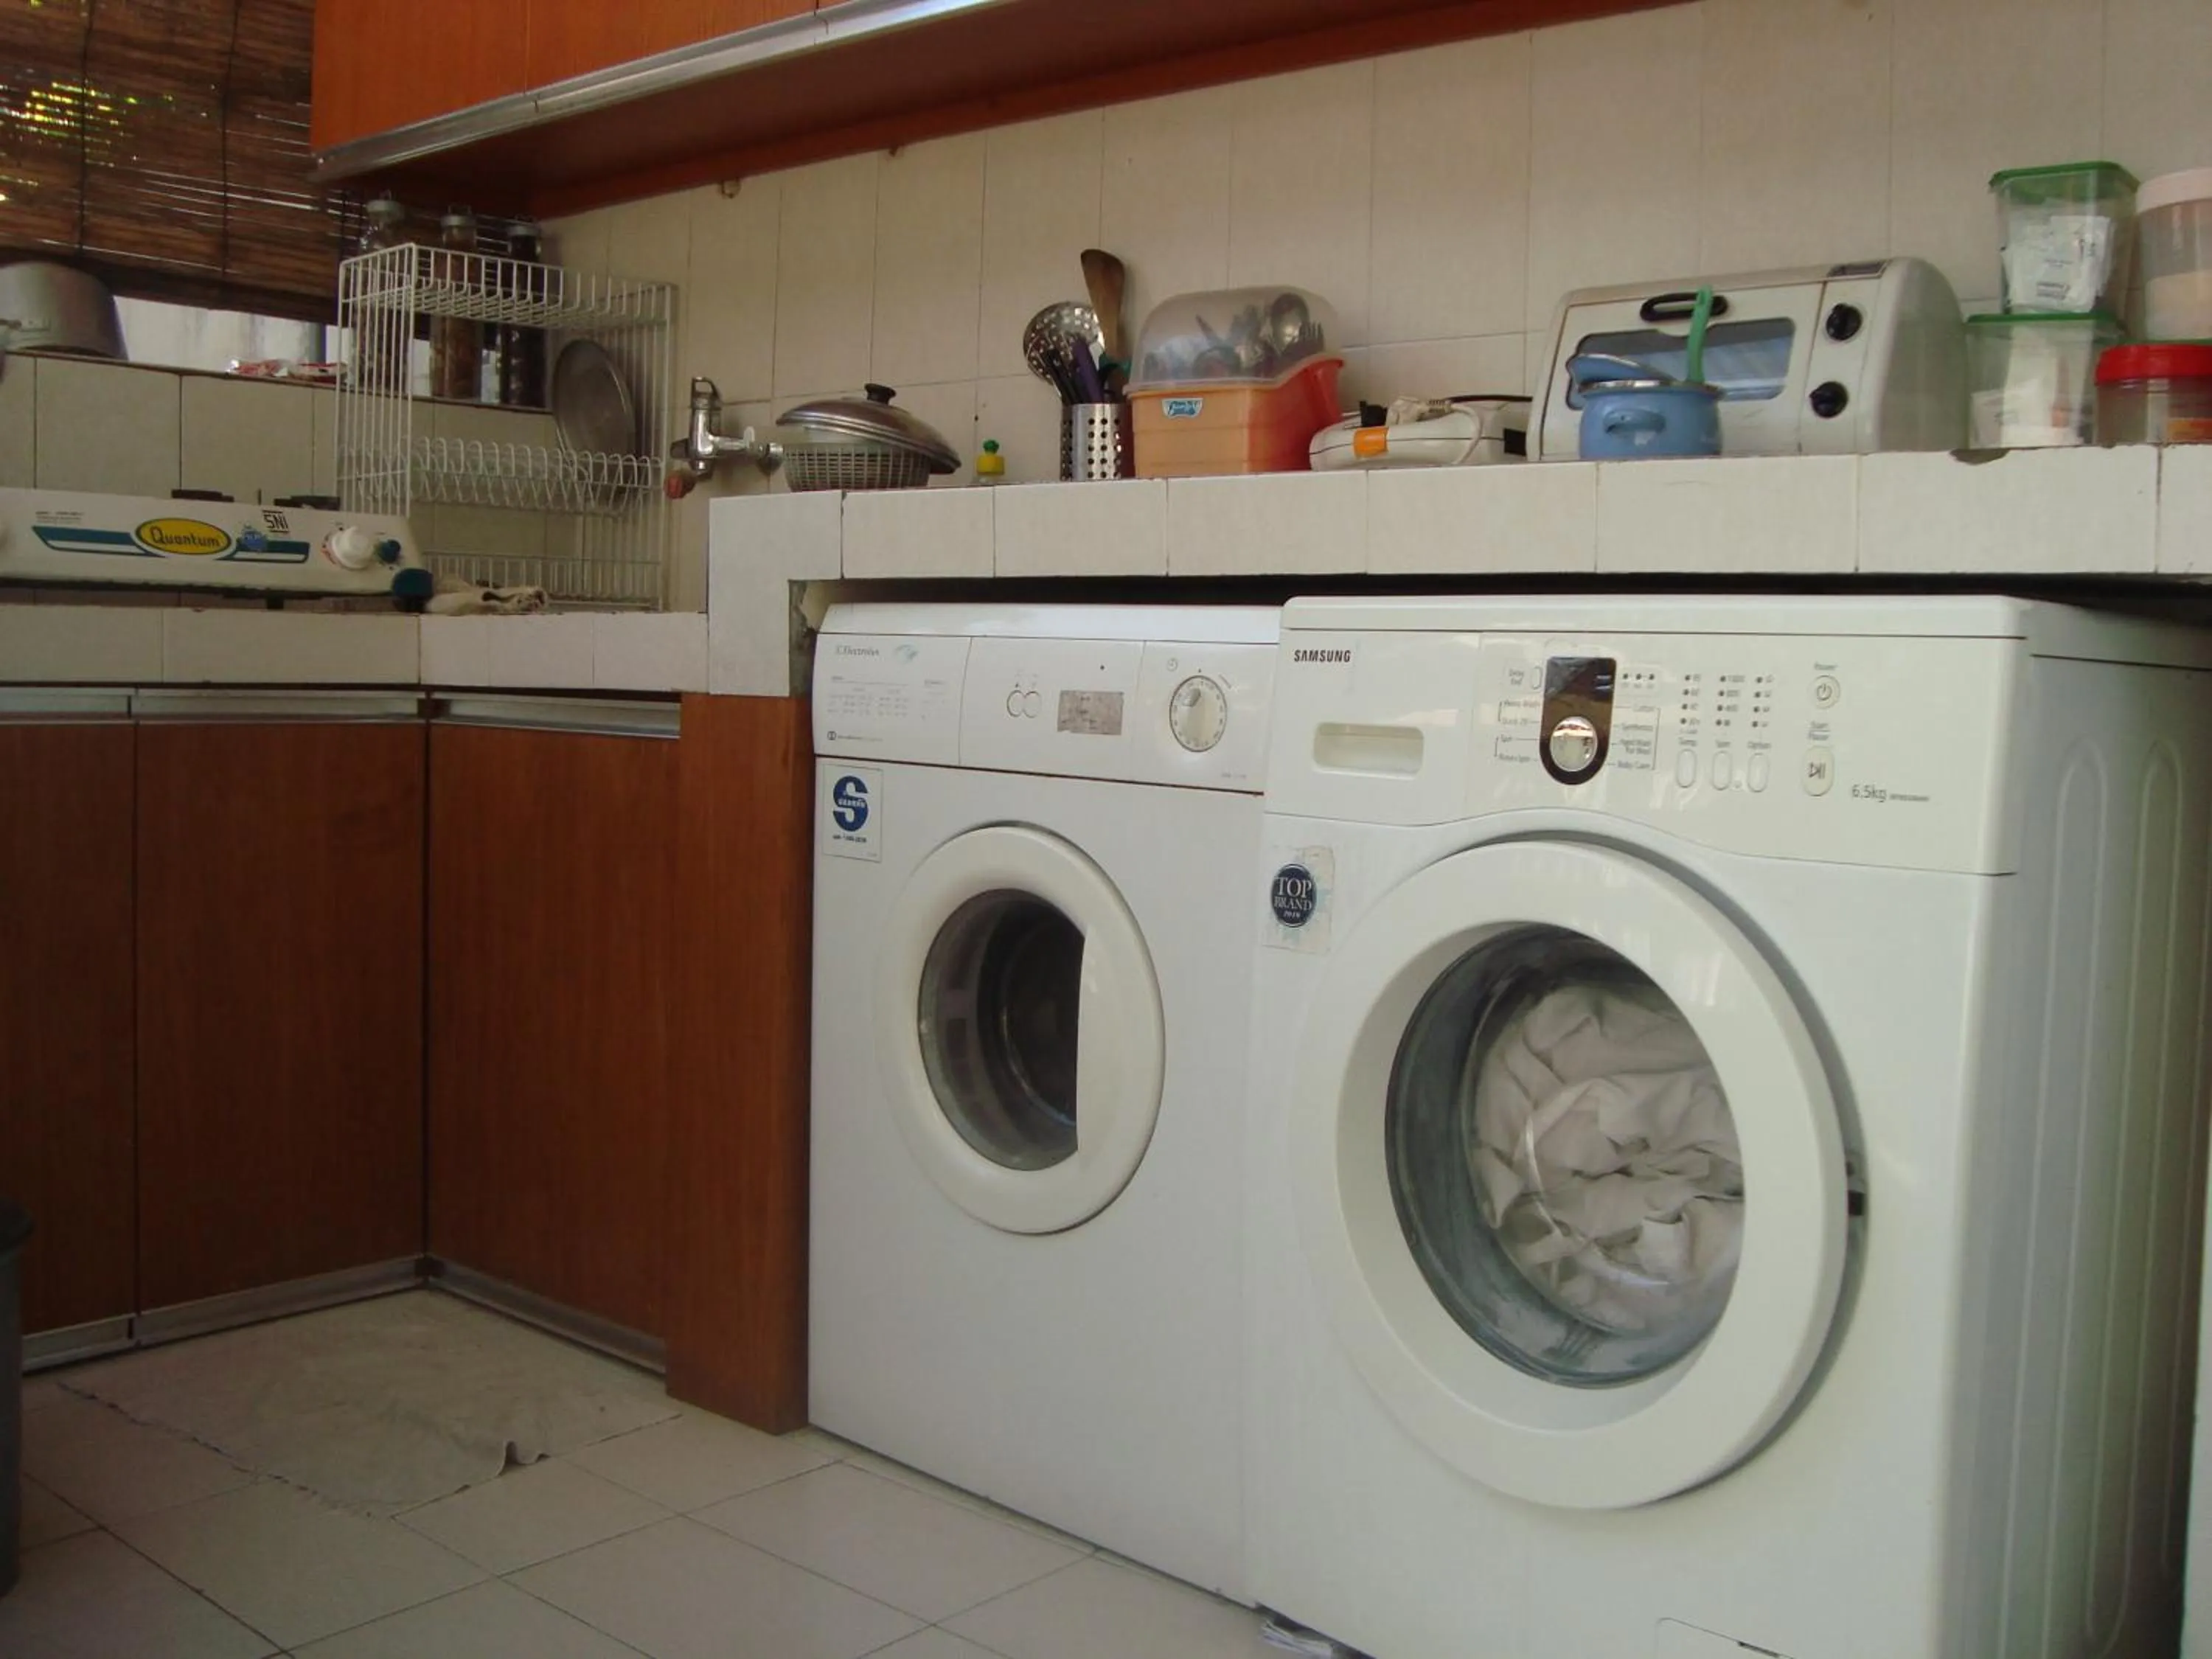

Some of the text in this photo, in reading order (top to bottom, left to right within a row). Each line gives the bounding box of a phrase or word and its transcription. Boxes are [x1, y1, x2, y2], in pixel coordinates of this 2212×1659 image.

[150, 525, 220, 547] Quantum
[1293, 649, 1352, 663] SAMSUNG
[1851, 782, 1888, 803] 6.5kg
[1274, 876, 1312, 898] TOP
[1274, 896, 1312, 911] BRAND
